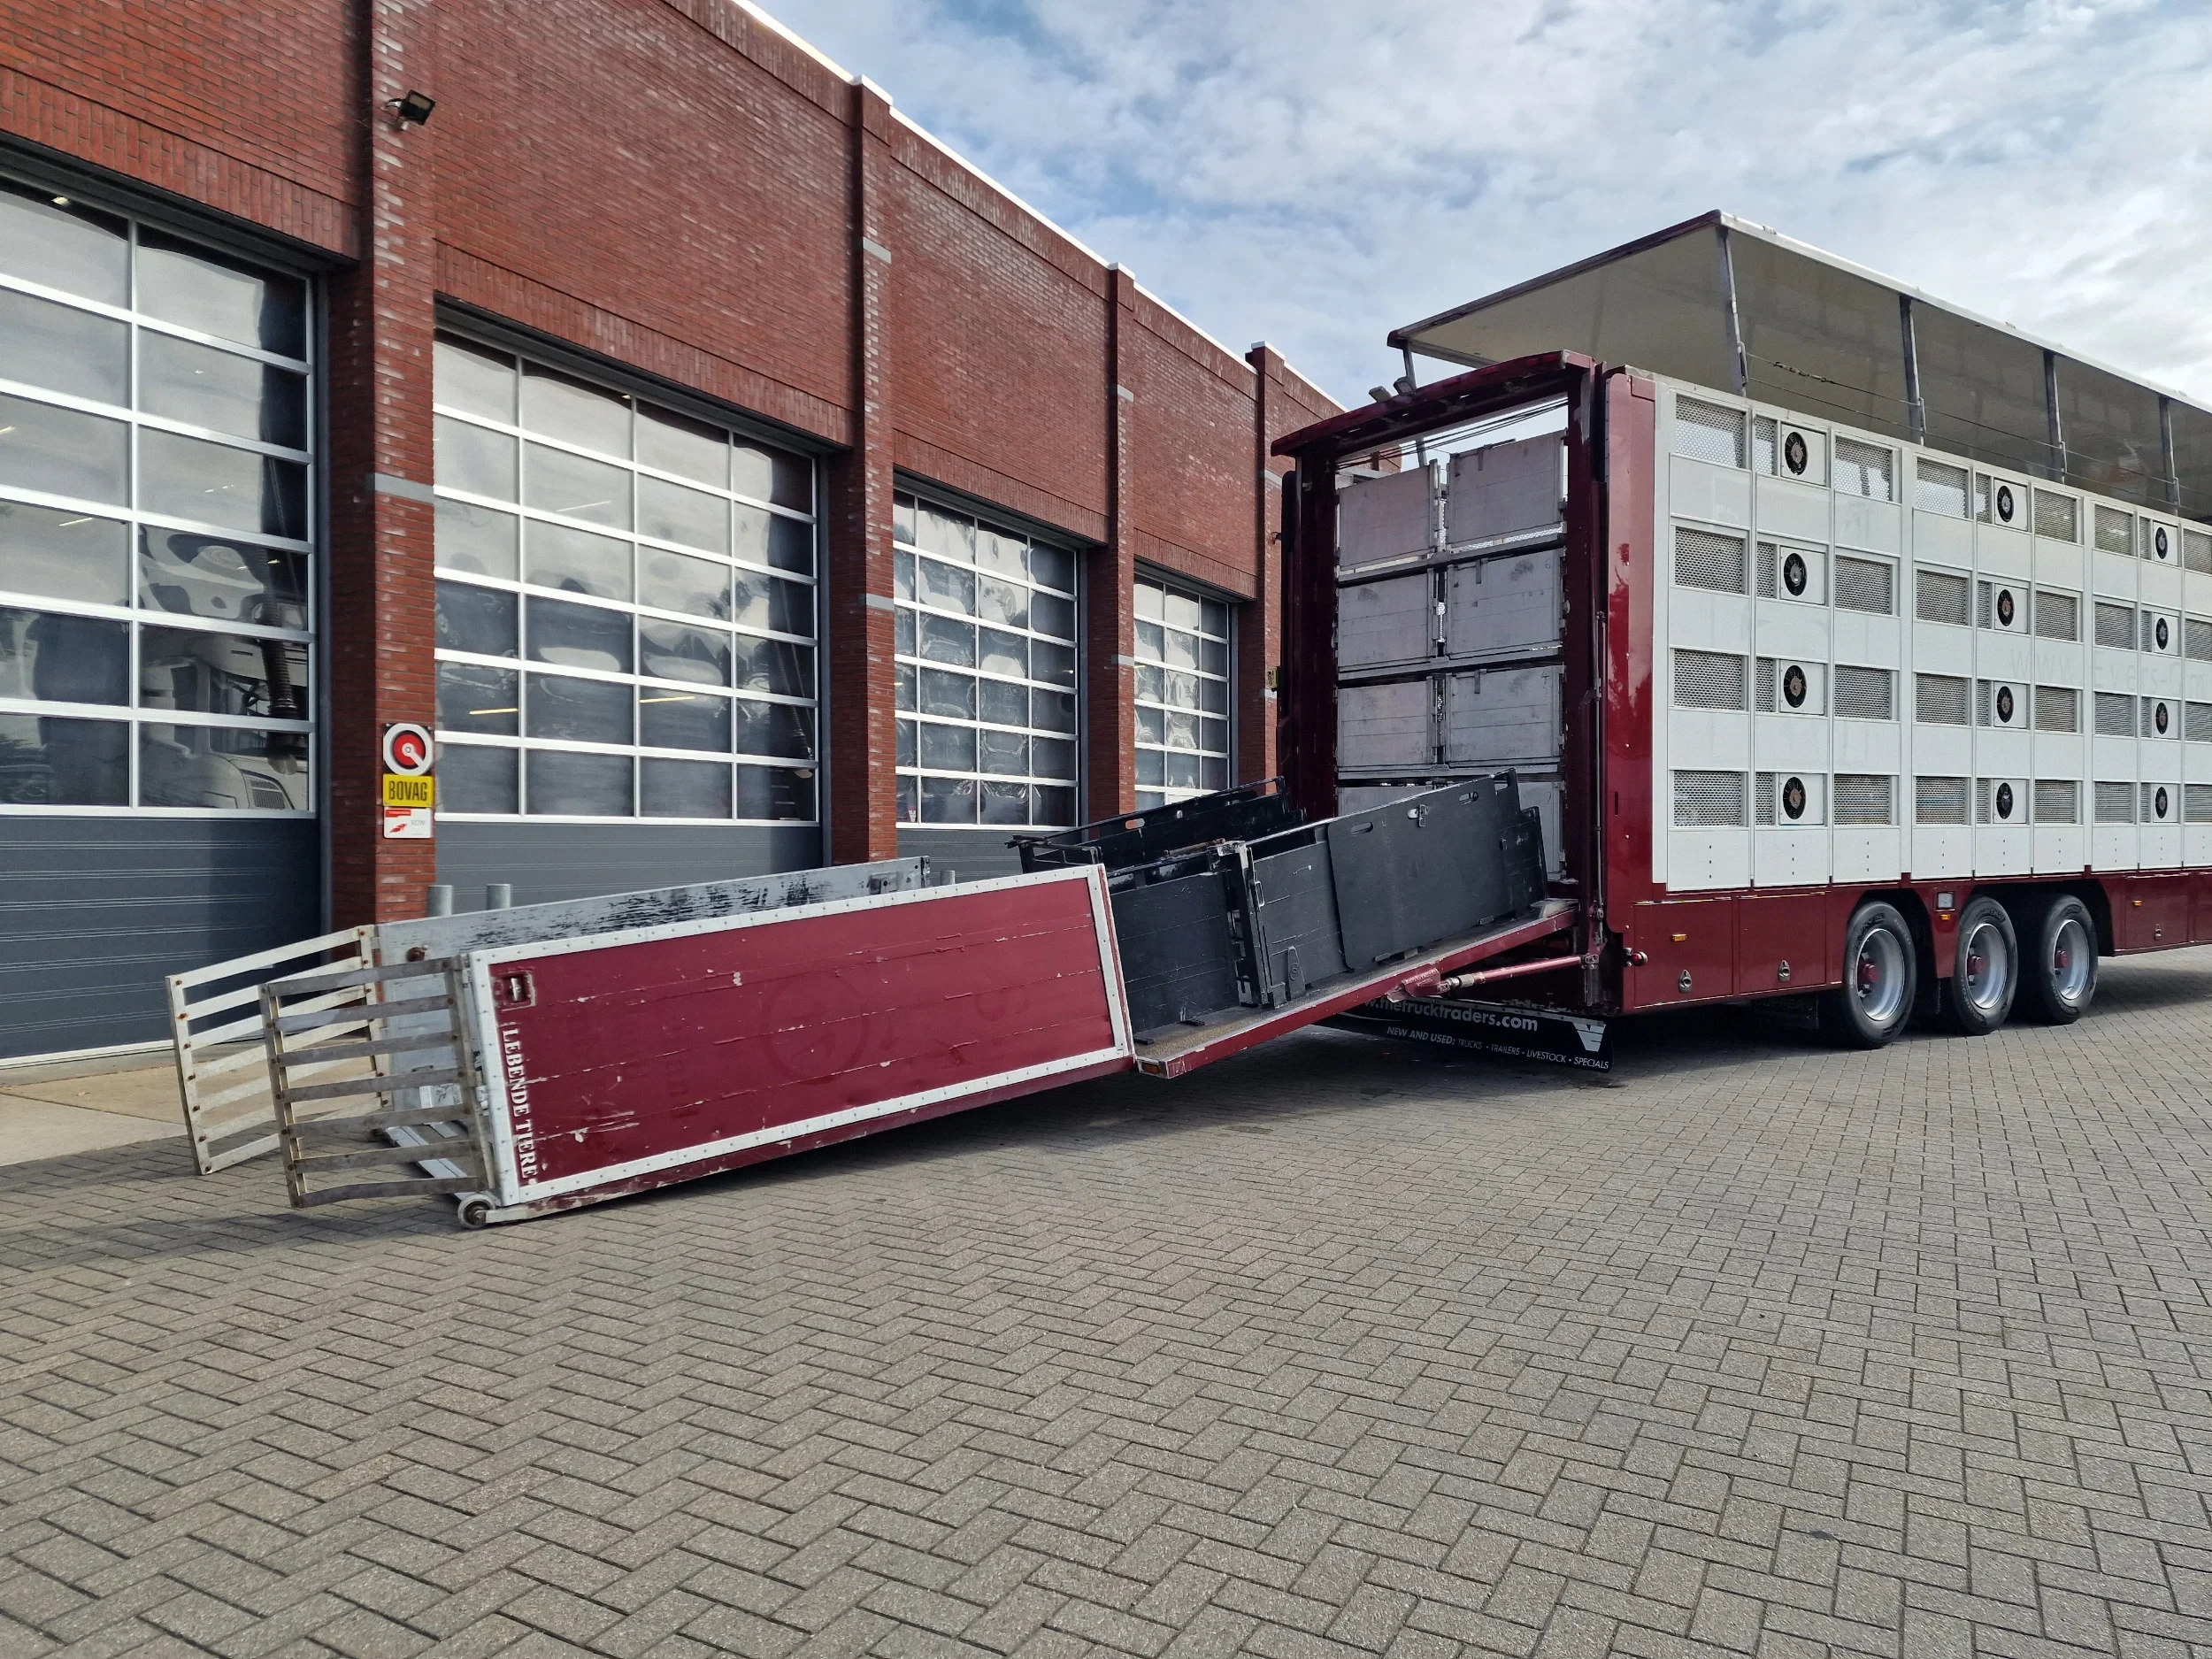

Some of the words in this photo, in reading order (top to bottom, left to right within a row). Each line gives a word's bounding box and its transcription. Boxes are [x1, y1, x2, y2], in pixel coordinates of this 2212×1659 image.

[388, 780, 427, 801] BOVAG
[503, 1028, 530, 1117] LEBENDE
[1387, 1026, 1407, 1037] NEW
[1409, 1031, 1428, 1041] AND
[1431, 1033, 1455, 1045] USED:
[1458, 1039, 1482, 1049] TRUCKS
[1491, 1044, 1520, 1056] TRAILERS
[1527, 1050, 1565, 1063] LIVESTOCK
[1574, 1057, 1609, 1069] SPECIALS
[516, 1119, 538, 1179] TIERE
